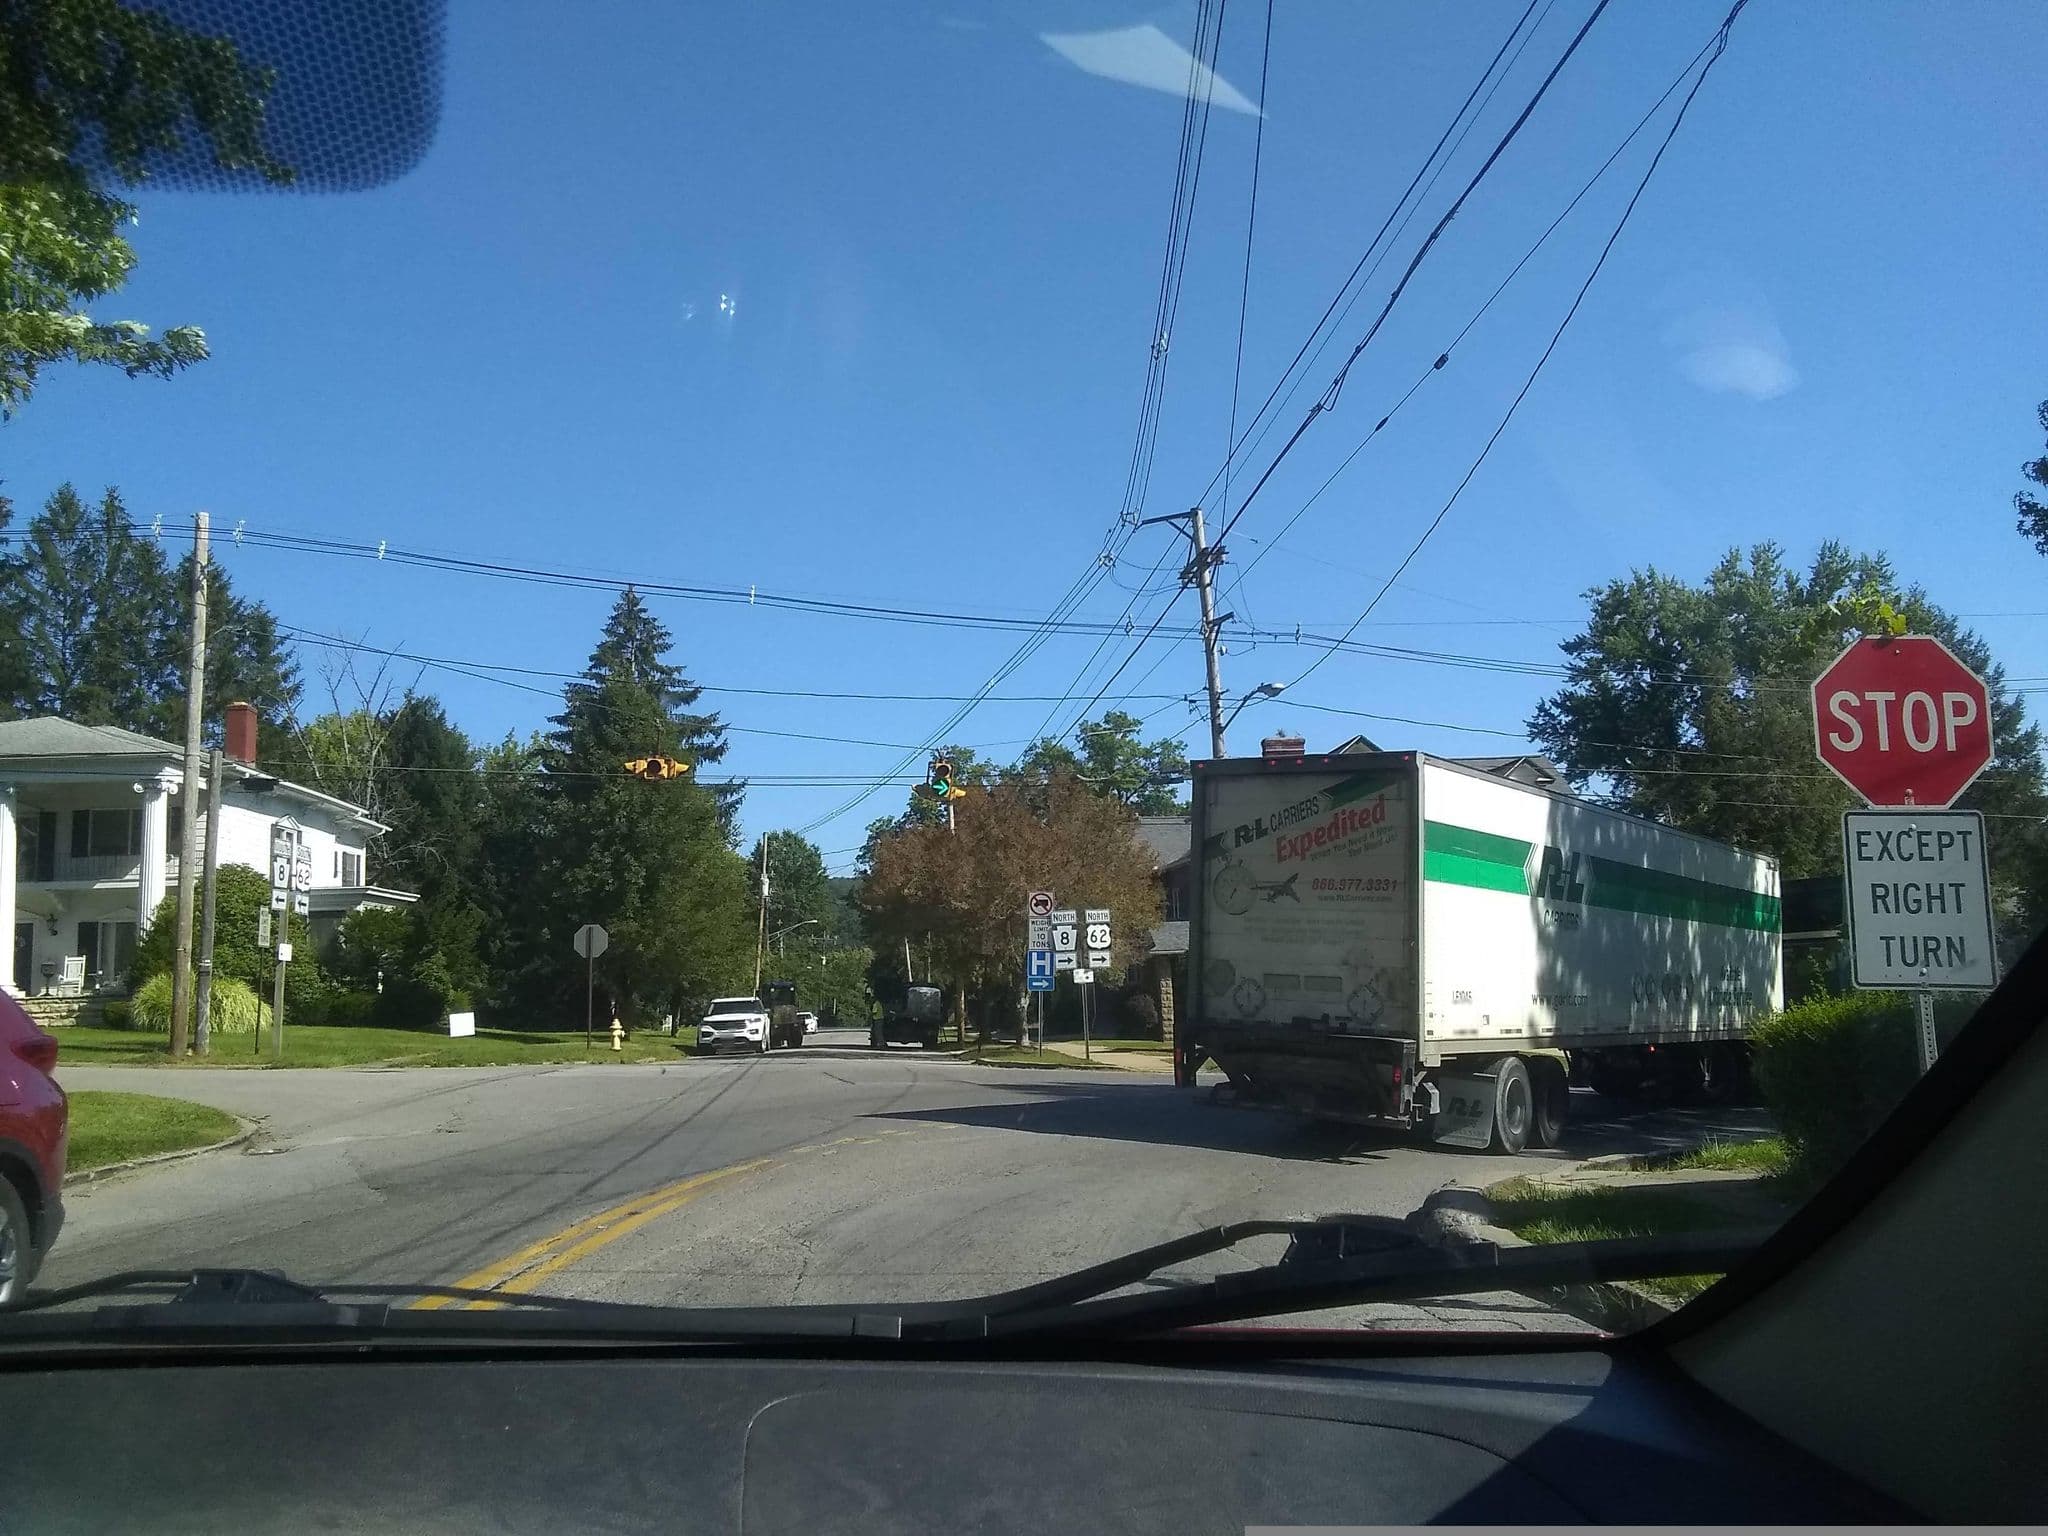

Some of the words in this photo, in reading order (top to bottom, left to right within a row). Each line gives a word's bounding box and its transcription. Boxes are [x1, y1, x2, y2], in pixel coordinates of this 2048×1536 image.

[1829, 690, 1978, 752] STOP
[1270, 796, 1320, 833] CARRIERS
[1276, 793, 1386, 864] Expedited
[1856, 830, 1973, 862] EXCEPT
[278, 865, 285, 881] 8
[298, 868, 310, 885] 62
[1870, 883, 1967, 915] RIGHT
[1053, 913, 1075, 921] NORTH
[1087, 912, 1108, 921] NORTH
[1061, 931, 1069, 945] 8
[1090, 929, 1107, 943] 62
[1031, 951, 1051, 976] H
[1879, 936, 1968, 968] TURN
